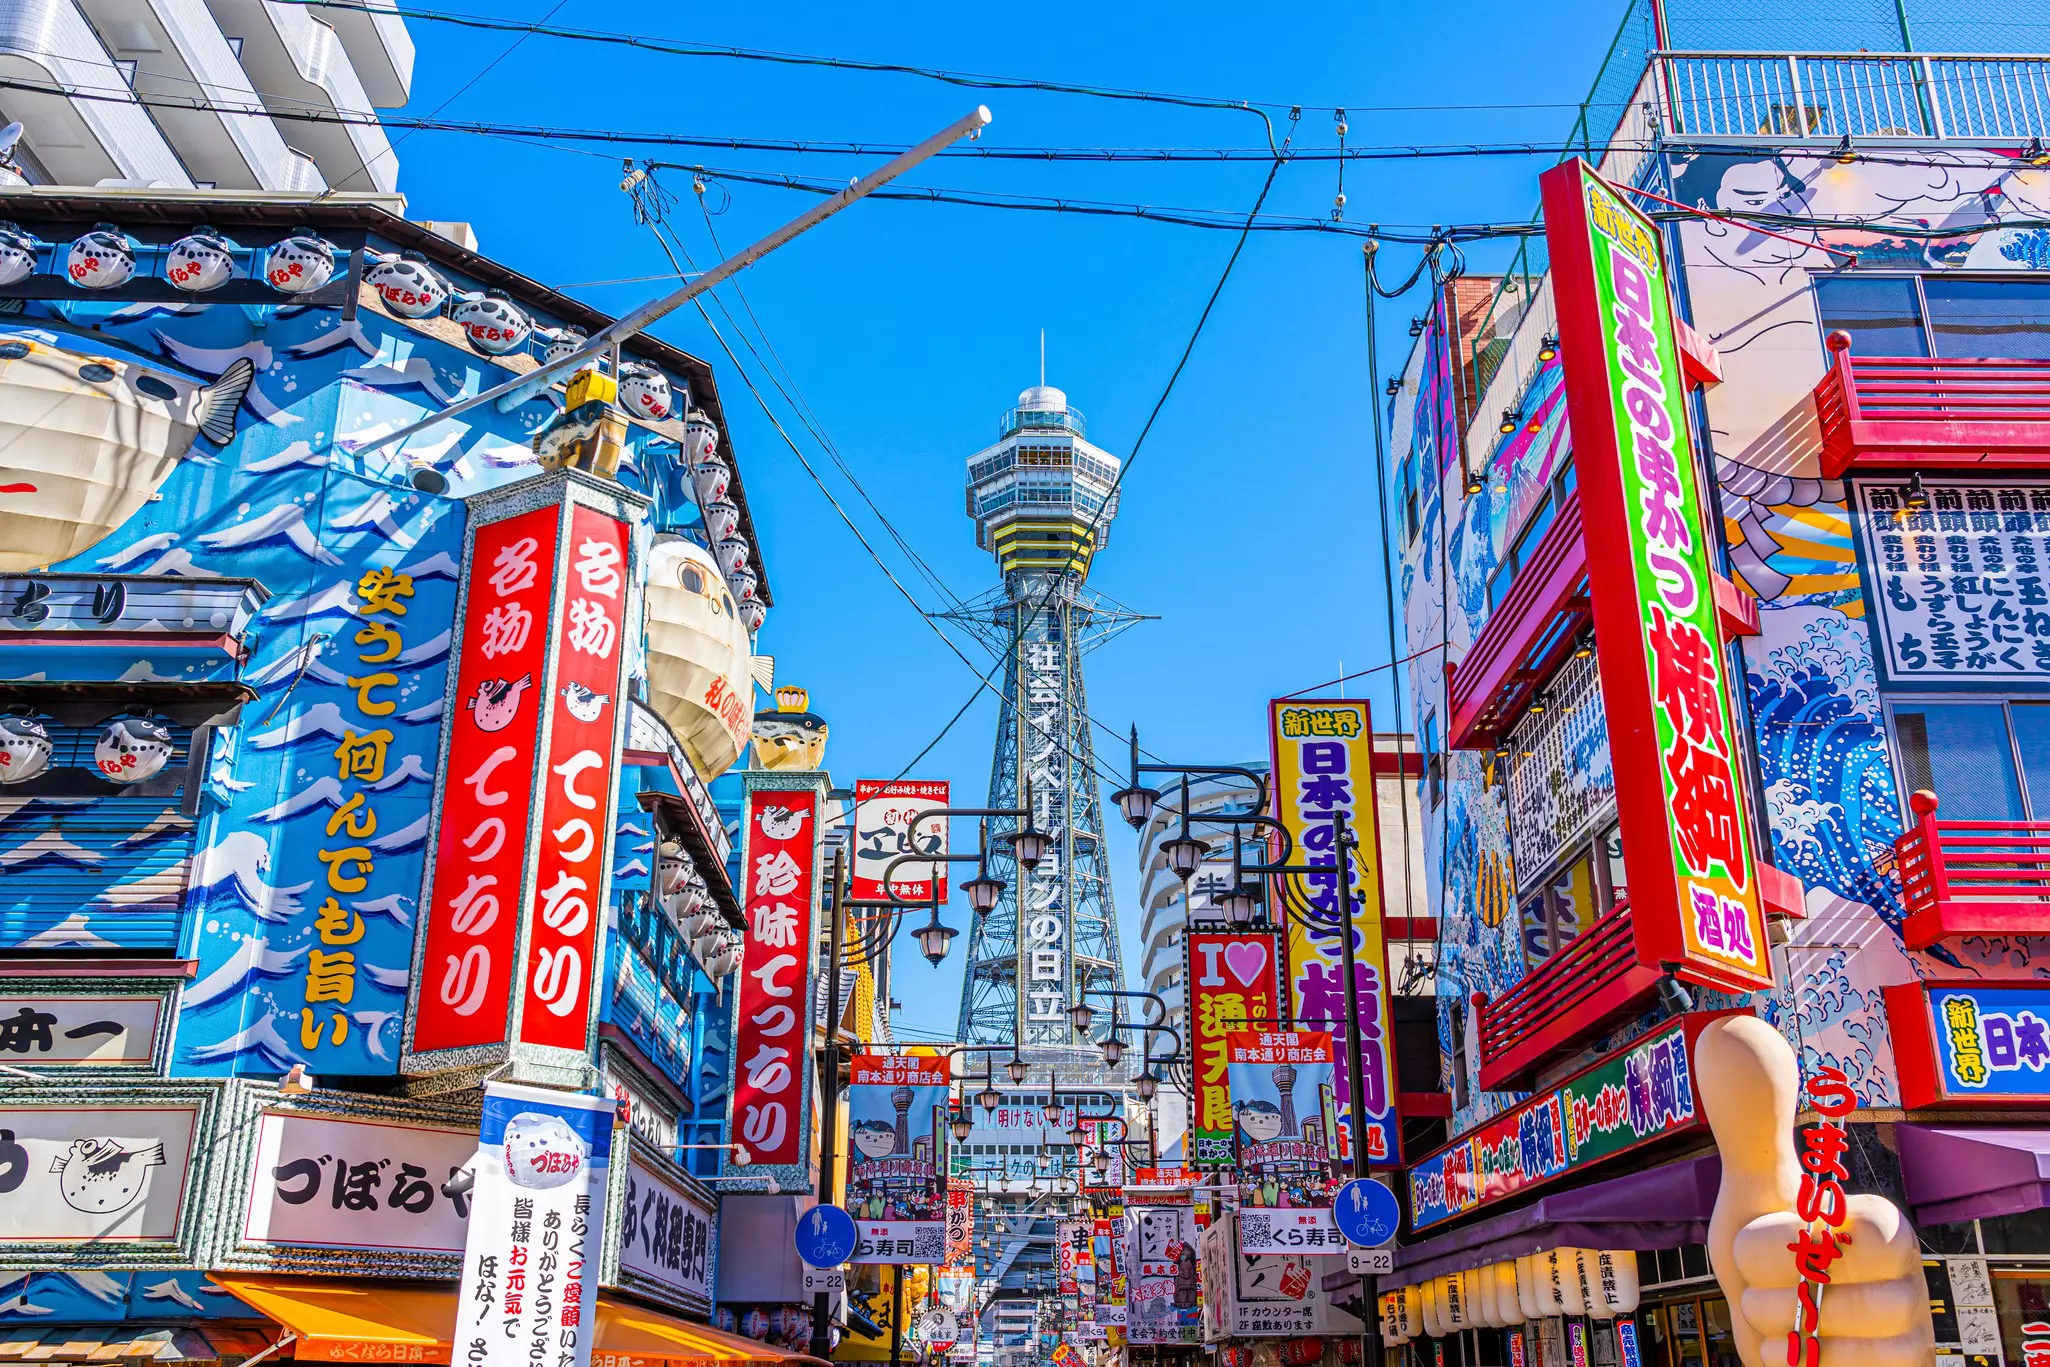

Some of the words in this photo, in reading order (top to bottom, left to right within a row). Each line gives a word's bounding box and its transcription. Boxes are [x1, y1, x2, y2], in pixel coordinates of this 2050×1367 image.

[1590, 187, 1656, 273] 新世界
[1612, 249, 1694, 610] 日本一の串かつ
[1933, 488, 1969, 533] 前頭
[1965, 488, 2002, 533] 前頭
[1997, 488, 2034, 533] 前頭
[481, 537, 538, 660] 名物
[568, 536, 621, 660] 名物
[1869, 488, 1903, 533] 前頭
[1887, 575, 1927, 669] もち
[1920, 575, 1964, 670] うずら玉子
[1948, 575, 1997, 670] 紅しょうが
[1982, 576, 2025, 671] にんにく
[1284, 710, 1359, 737] 新世界
[1648, 605, 1746, 890] 横綱
[300, 564, 415, 1050] 安うて何んでも旨い
[439, 745, 517, 1017] てっちり
[533, 748, 604, 1017] てっちり
[875, 883, 925, 896] 年中無休
[1693, 886, 1754, 960] 酒処
[1197, 943, 1224, 986] I
[743, 849, 802, 1152] 珍味てっちり
[883, 1057, 919, 1071] 通天閣
[1234, 1047, 1327, 1062] 南本通り商店会
[1259, 1032, 1299, 1047] 通天閣
[1945, 999, 1986, 1083] 新世界
[857, 1070, 944, 1085] 南本通り商店会
[1625, 1041, 1678, 1134] 横綱
[1670, 1034, 1692, 1117] 酒処
[1198, 1138, 1229, 1147] 日本一の
[1519, 1101, 1555, 1181] 横綱
[1573, 1085, 1628, 1143] 日本一の串かつ
[1127, 1195, 1190, 1205] 元祖串カツ専門店
[1156, 1168, 1182, 1178] 通天閣
[1443, 1148, 1468, 1212] 横綱
[624, 1176, 707, 1284] ふぐ料理専門
[947, 1186, 968, 1241] 串かつ
[1271, 1227, 1348, 1247] くら寿司
[1298, 1215, 1317, 1225] 無添
[502, 1197, 533, 1339] 皆様お元気で
[529, 1209, 561, 1367] ありがとうござ
[1130, 1280, 1176, 1303] 大阪名物
[1239, 1307, 1248, 1317] 1F
[1252, 1306, 1312, 1317] カウンター席
[1239, 1321, 1249, 1331] 2F
[1252, 1320, 1313, 1331] 座敷あります
[329, 1342, 439, 1360] ふぐなら日本一
[467, 1338, 488, 1367] さ
